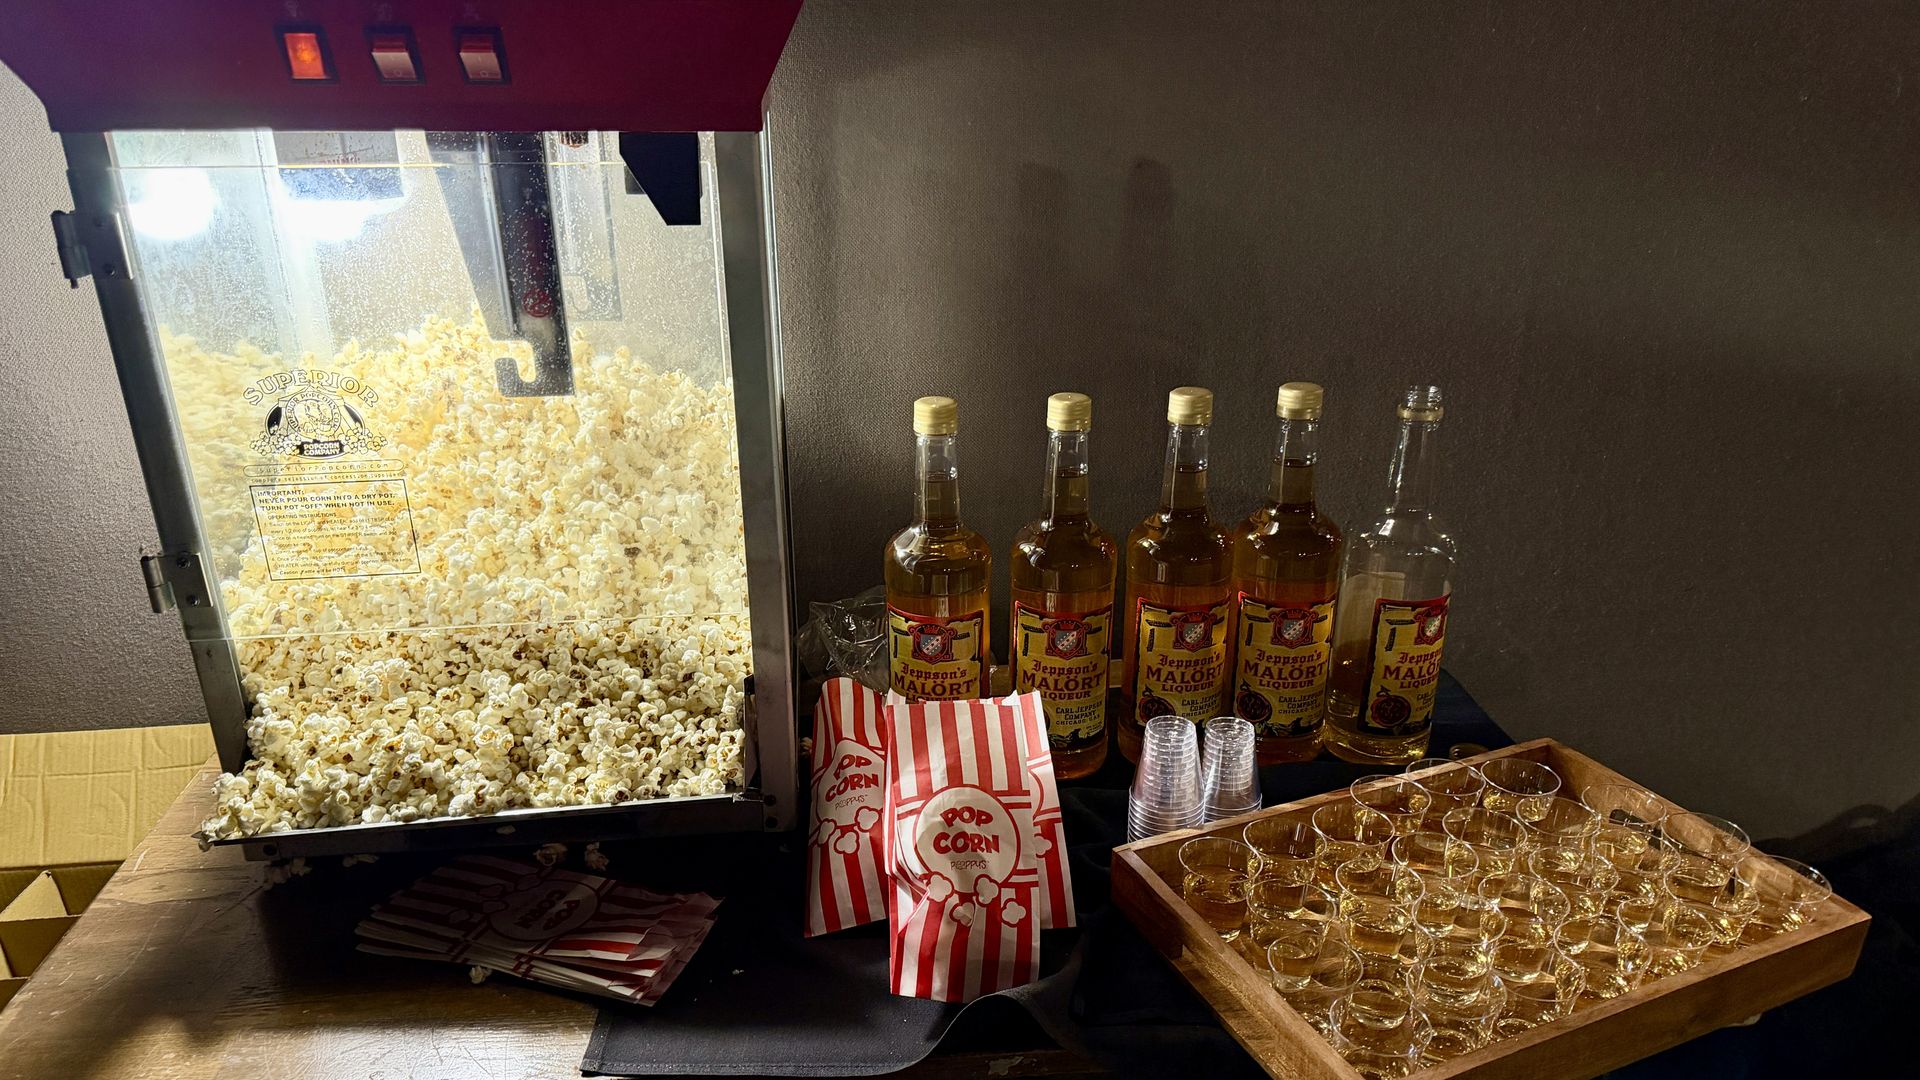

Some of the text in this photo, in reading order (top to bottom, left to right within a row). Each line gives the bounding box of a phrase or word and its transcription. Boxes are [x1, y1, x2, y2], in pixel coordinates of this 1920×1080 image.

[243, 369, 379, 407] SUPERIOR
[303, 441, 340, 450] POPCORN
[303, 448, 341, 456] COMPANY
[1158, 652, 1220, 670] Jeppson's
[1256, 649, 1321, 666] Jeppson's
[901, 662, 968, 681] Jeppson's
[1032, 660, 1098, 678] Jeppson's
[1147, 663, 1223, 685] MALÖRT
[1244, 659, 1323, 680] MALÖRT
[895, 671, 974, 697] MALÖRT
[1023, 669, 1102, 692] MALÖRT
[1161, 681, 1214, 693] LIQUEUR
[1259, 679, 1314, 690] LIQUEUR
[1040, 690, 1091, 700] IQUEUR
[1279, 695, 1297, 703] CARL
[1056, 706, 1074, 714] CARL
[1065, 710, 1095, 721] COMPANY
[834, 754, 872, 781] POP
[825, 773, 880, 802] CORN
[940, 806, 994, 828] POP
[933, 831, 1000, 854] CORN
